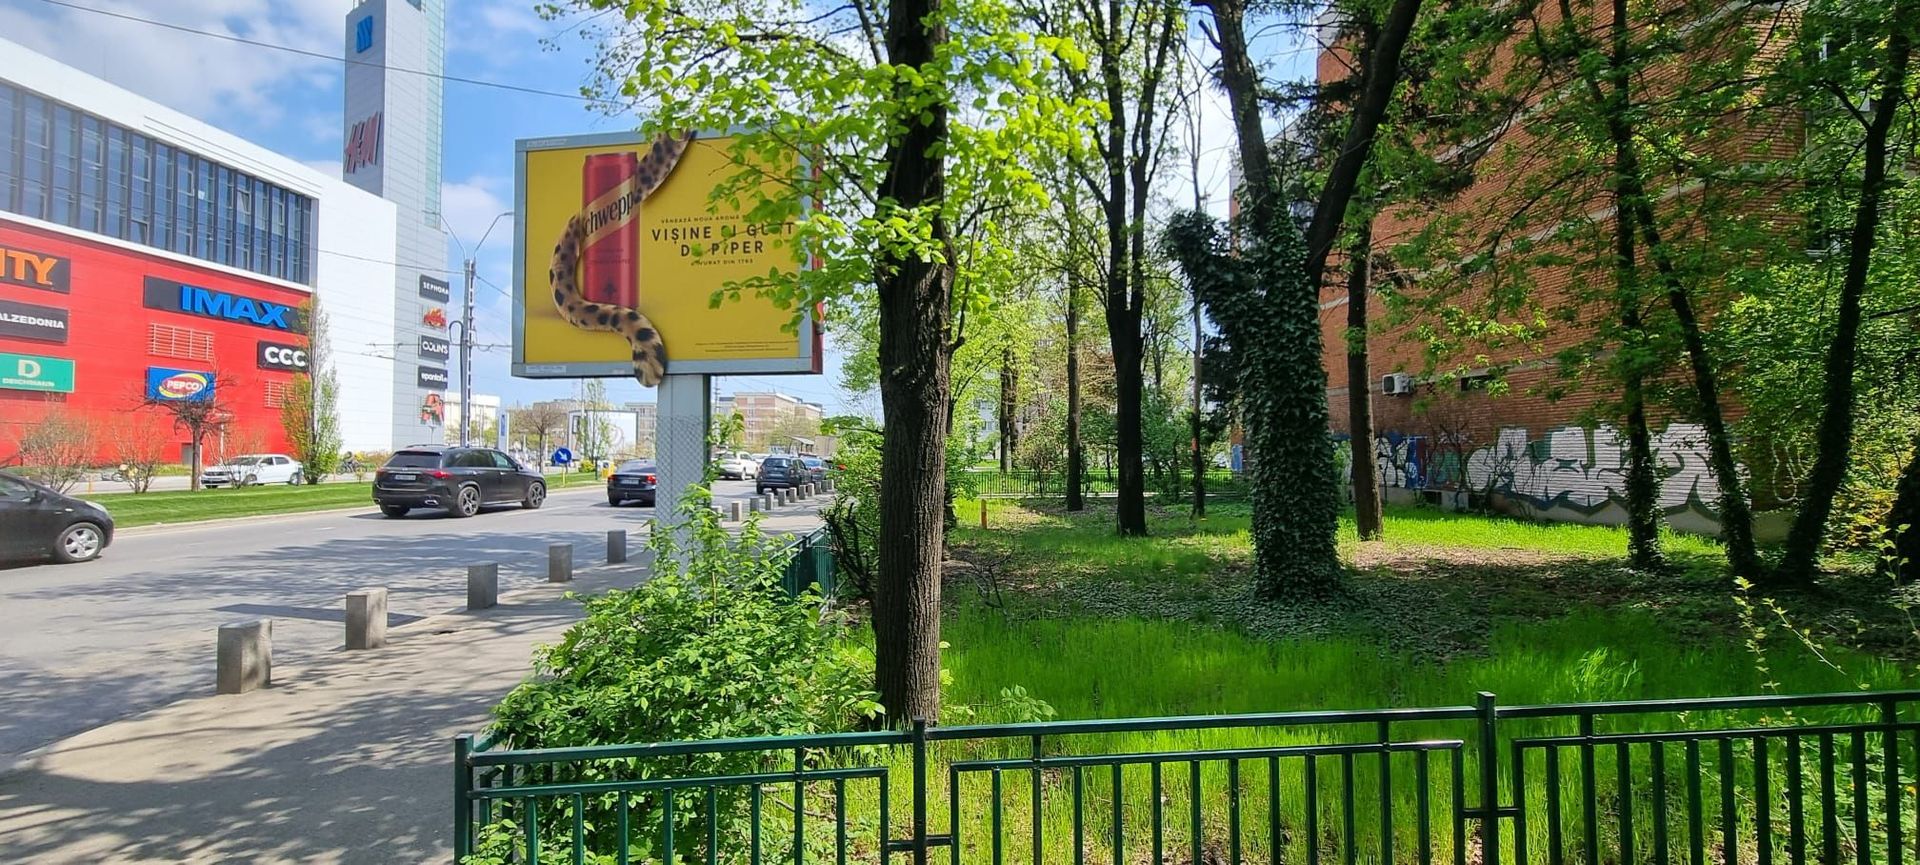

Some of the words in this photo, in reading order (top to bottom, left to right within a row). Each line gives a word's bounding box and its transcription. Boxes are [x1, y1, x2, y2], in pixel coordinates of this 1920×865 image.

[652, 226, 711, 244] VIȘINE
[721, 223, 736, 238] I
[747, 221, 794, 237] GUT
[181, 284, 288, 328] IMAX
[264, 346, 306, 367] CCC
[18, 359, 41, 378] D
[166, 379, 200, 391] PEPCO
